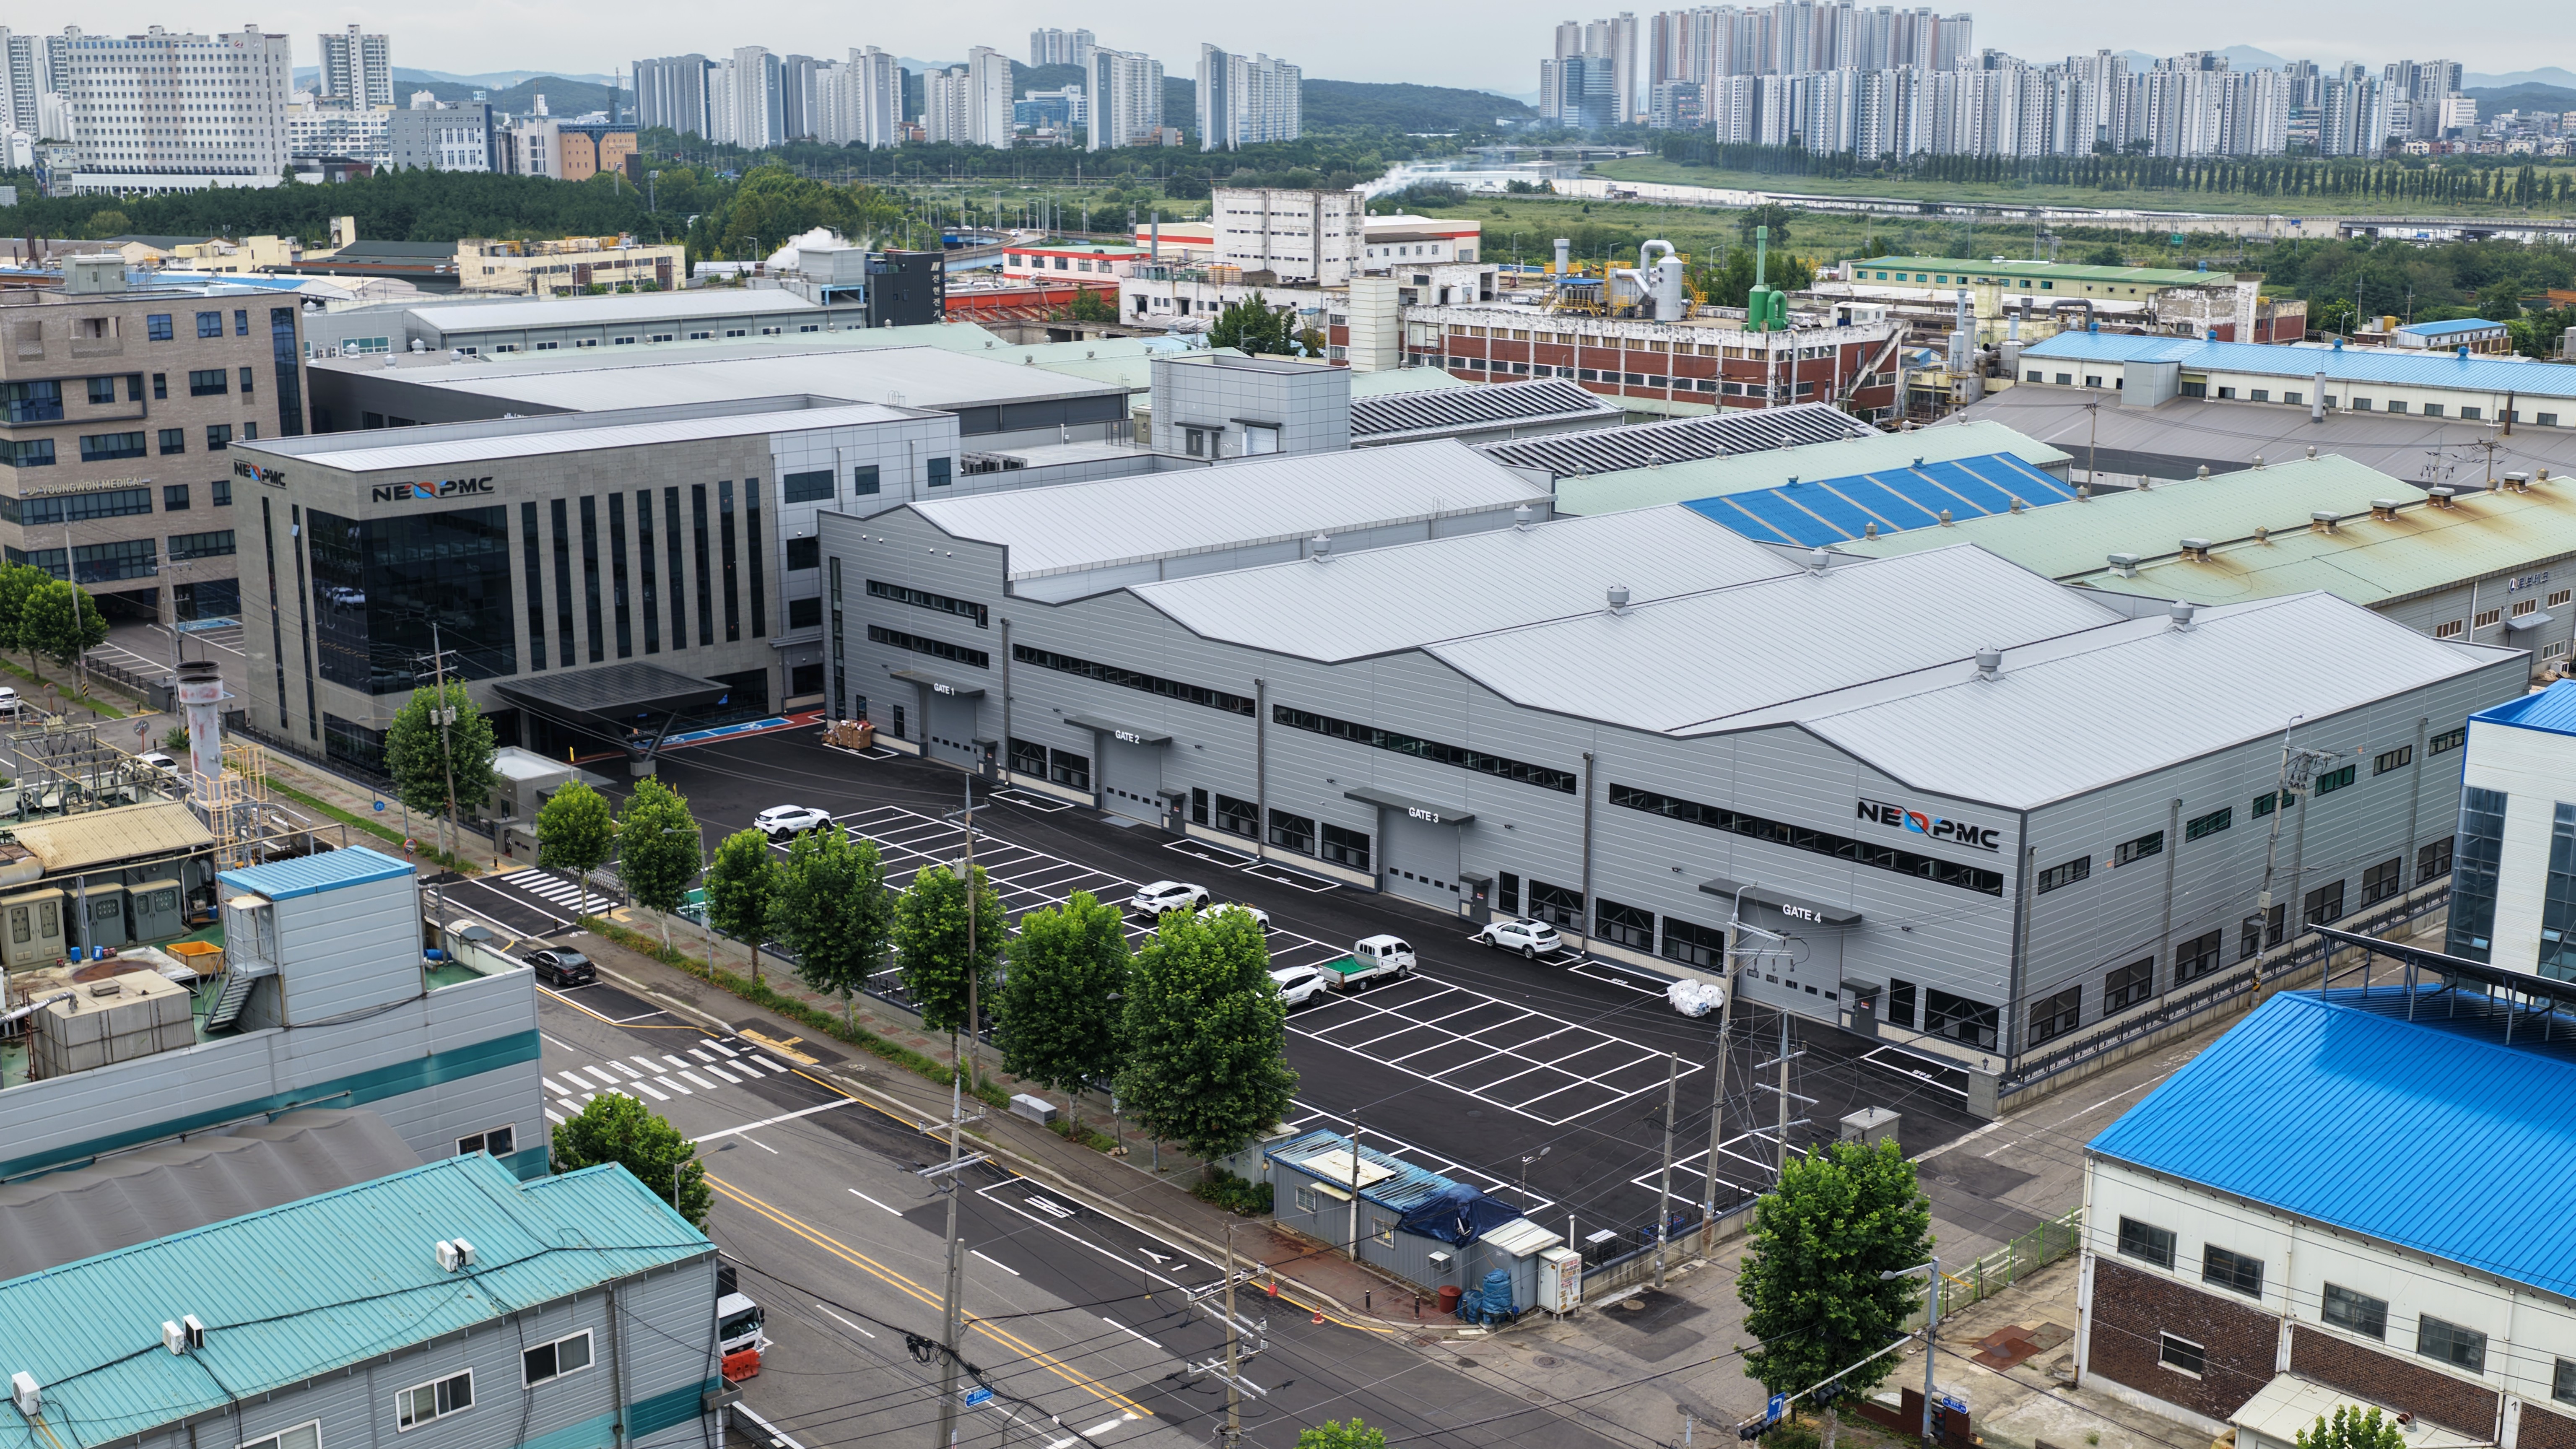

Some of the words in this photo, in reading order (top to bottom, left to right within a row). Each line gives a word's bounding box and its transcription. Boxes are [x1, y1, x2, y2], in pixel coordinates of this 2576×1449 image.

[234, 462, 286, 487] NEOPMC
[42, 482, 99, 495] YOUNGWON
[102, 476, 145, 489] MEDICAL
[372, 477, 493, 503] NEOPMC
[934, 683, 950, 694] GATE
[951, 687, 954, 696] 1
[1115, 730, 1134, 742] GATE
[1135, 735, 1140, 744] 2
[1409, 807, 1431, 821] GATE
[1433, 813, 1439, 823] 3
[1857, 801, 2000, 849] NEOPMC
[1783, 904, 1812, 921] GATE
[1814, 912, 1821, 923] 4
